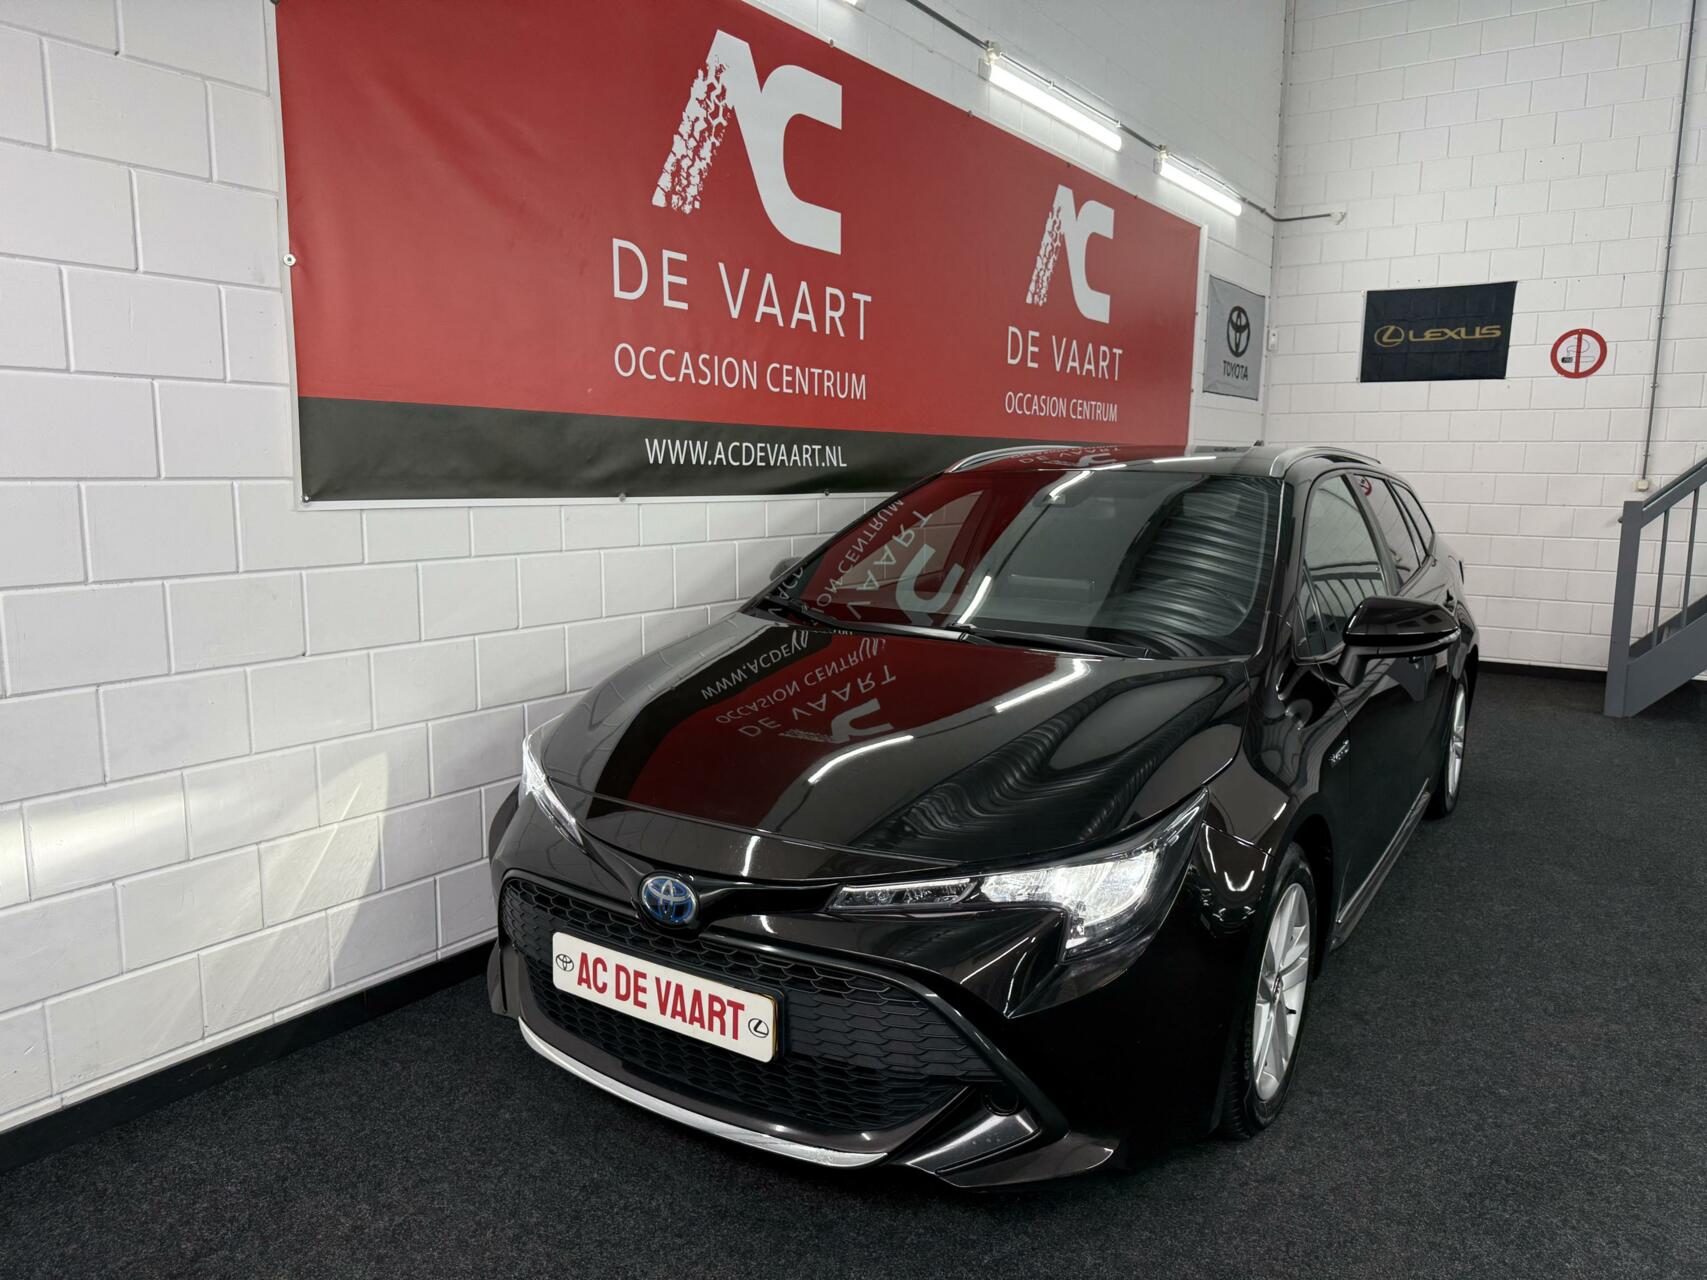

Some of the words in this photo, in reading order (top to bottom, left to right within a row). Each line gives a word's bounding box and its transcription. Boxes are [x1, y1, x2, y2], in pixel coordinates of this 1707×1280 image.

[612, 237, 689, 311] DE
[718, 261, 872, 341] VAART
[1007, 325, 1040, 369] DE
[1052, 335, 1123, 381] VAART
[1408, 325, 1501, 342] LEXUS
[614, 342, 757, 390] OCCASION
[766, 362, 867, 401] CENTRUM
[1223, 360, 1248, 381] TOYOTA
[1005, 391, 1067, 418] OCCASION
[1069, 399, 1118, 422] CENTRUM
[644, 437, 848, 468] WWW.ACDEVAART.NL
[577, 951, 608, 994] AC
[615, 963, 647, 1009] DE
[655, 976, 745, 1040] VAART
